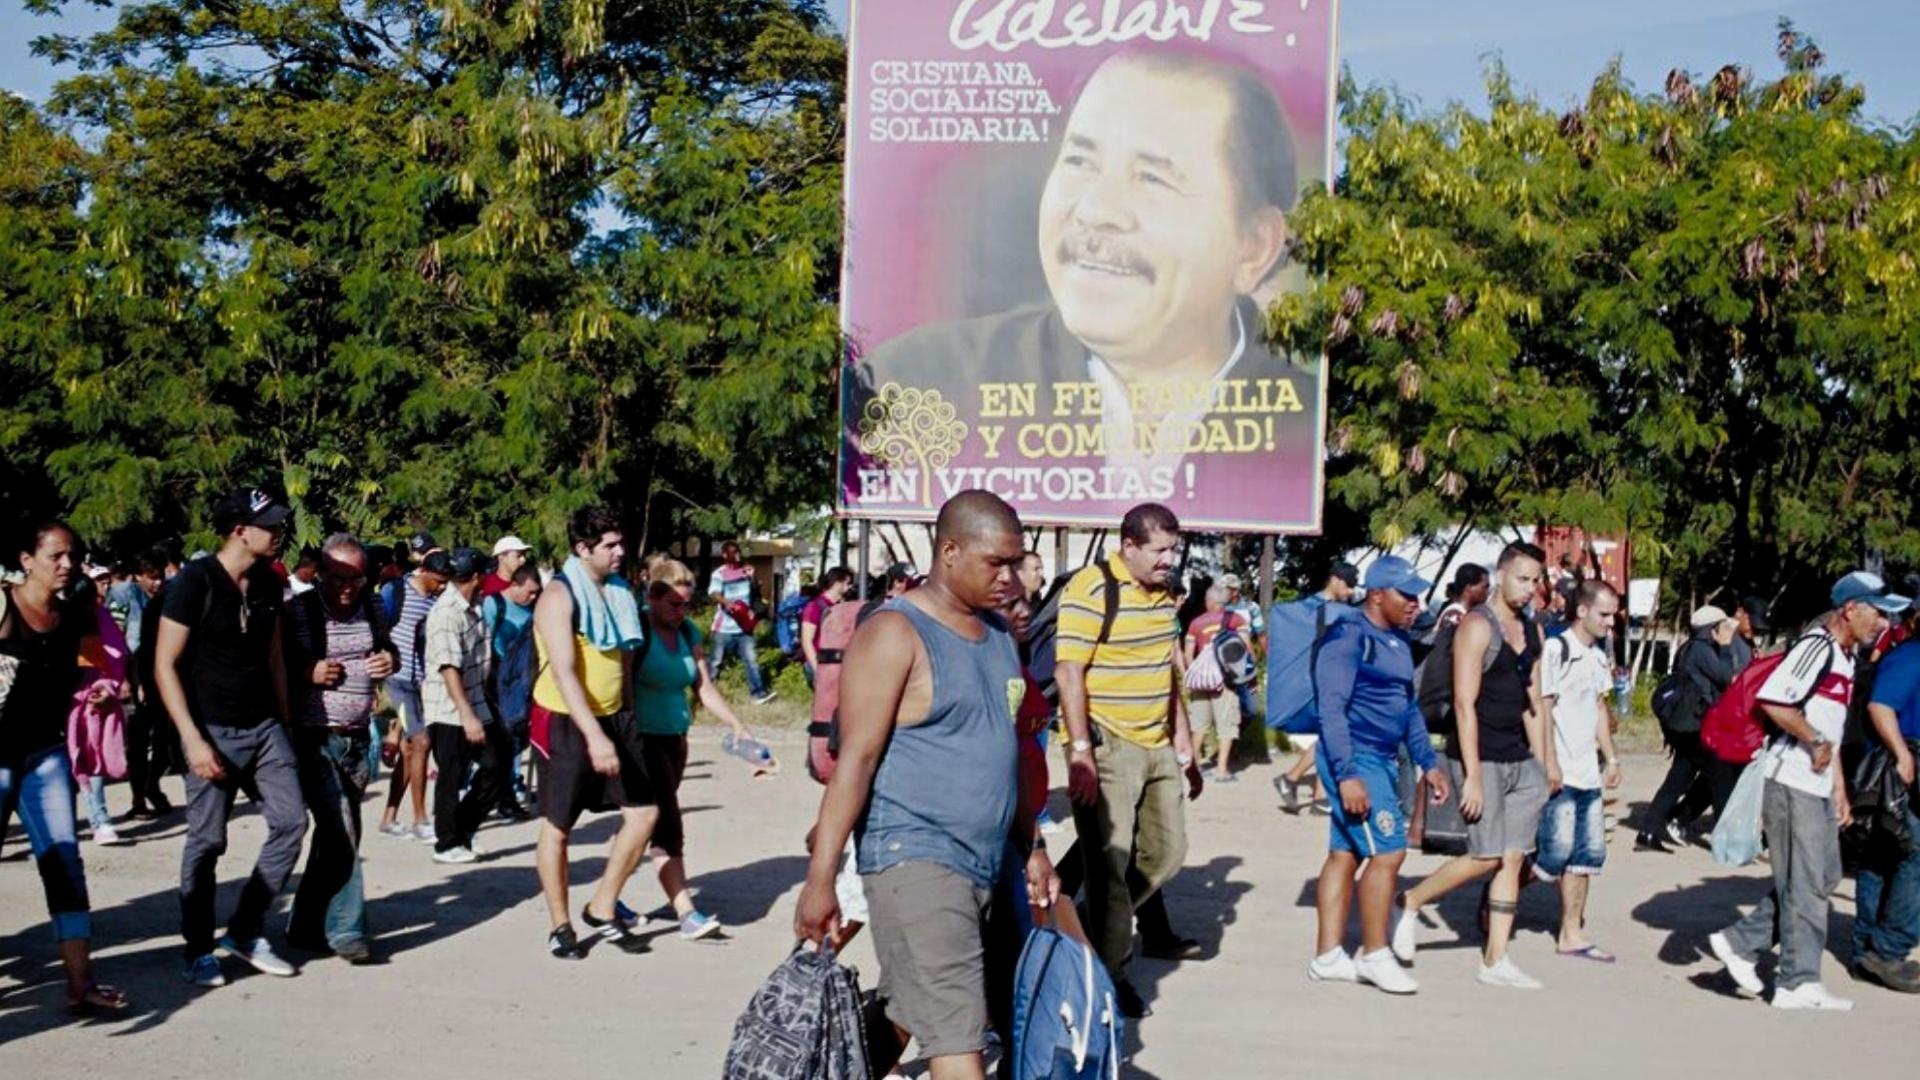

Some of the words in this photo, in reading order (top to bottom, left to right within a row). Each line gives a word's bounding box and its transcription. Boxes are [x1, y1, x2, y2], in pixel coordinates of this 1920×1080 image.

[870, 60, 1043, 87] CRISTIANA,
[870, 88, 1062, 115] SOCIALISTA,
[869, 116, 1049, 142] SOLIDARIA!
[979, 382, 1037, 418] EN
[1053, 381, 1103, 417] FE
[1128, 377, 1303, 414] FAMILIA
[978, 425, 1005, 459] Y
[1017, 417, 1277, 458] COMUNIDAD!
[857, 467, 919, 503] EN
